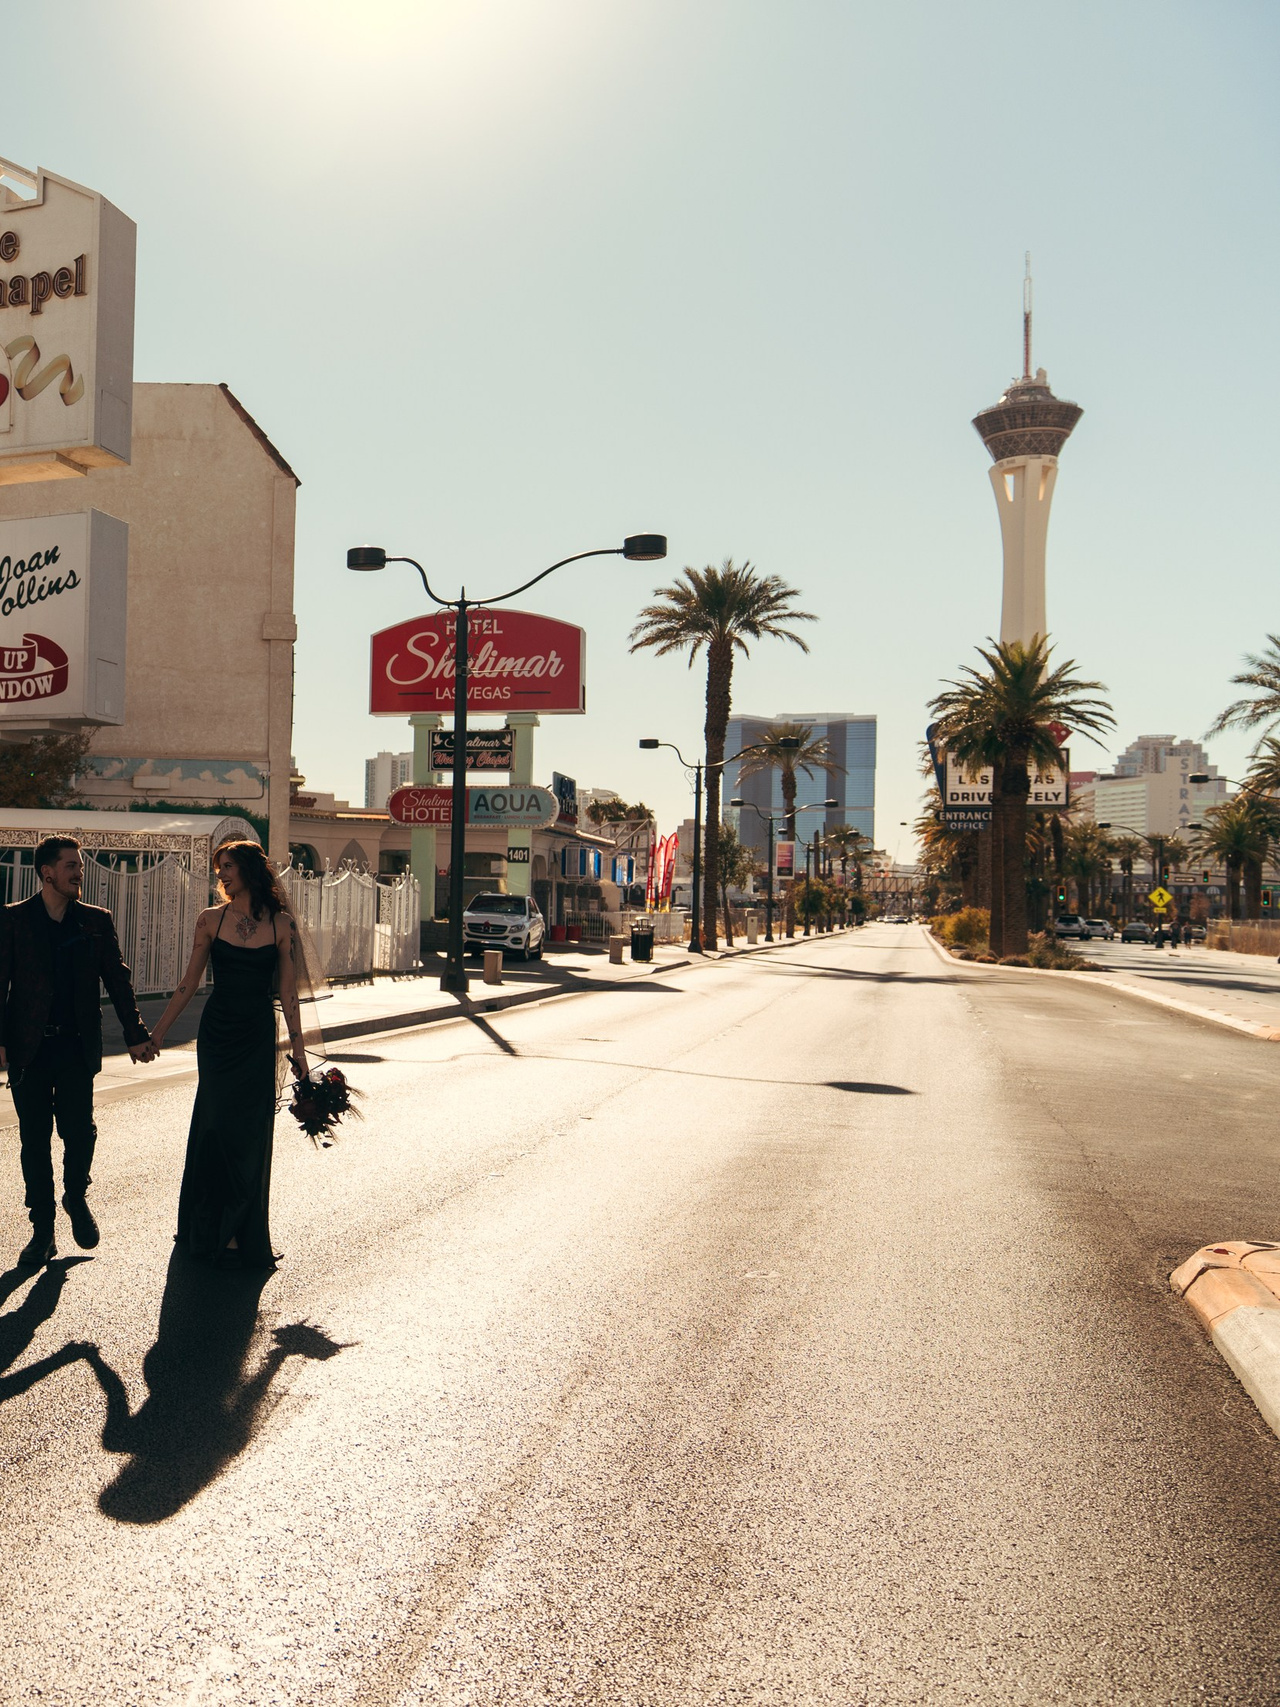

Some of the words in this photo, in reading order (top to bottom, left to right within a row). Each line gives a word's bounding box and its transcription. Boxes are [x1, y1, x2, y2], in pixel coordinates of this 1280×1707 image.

[446, 618, 503, 635] HTEL
[3, 650, 29, 670] UP
[466, 686, 511, 700] VEGAS
[444, 733, 500, 748] Salimar
[476, 751, 511, 767] Chapel
[958, 775, 989, 785] LAS
[402, 790, 453, 807] Shalima
[474, 793, 542, 812] AQUA
[950, 792, 994, 802] DRIVE
[1027, 792, 1062, 802] FELY
[950, 821, 984, 830] OFFICE
[508, 849, 529, 861] 1401
